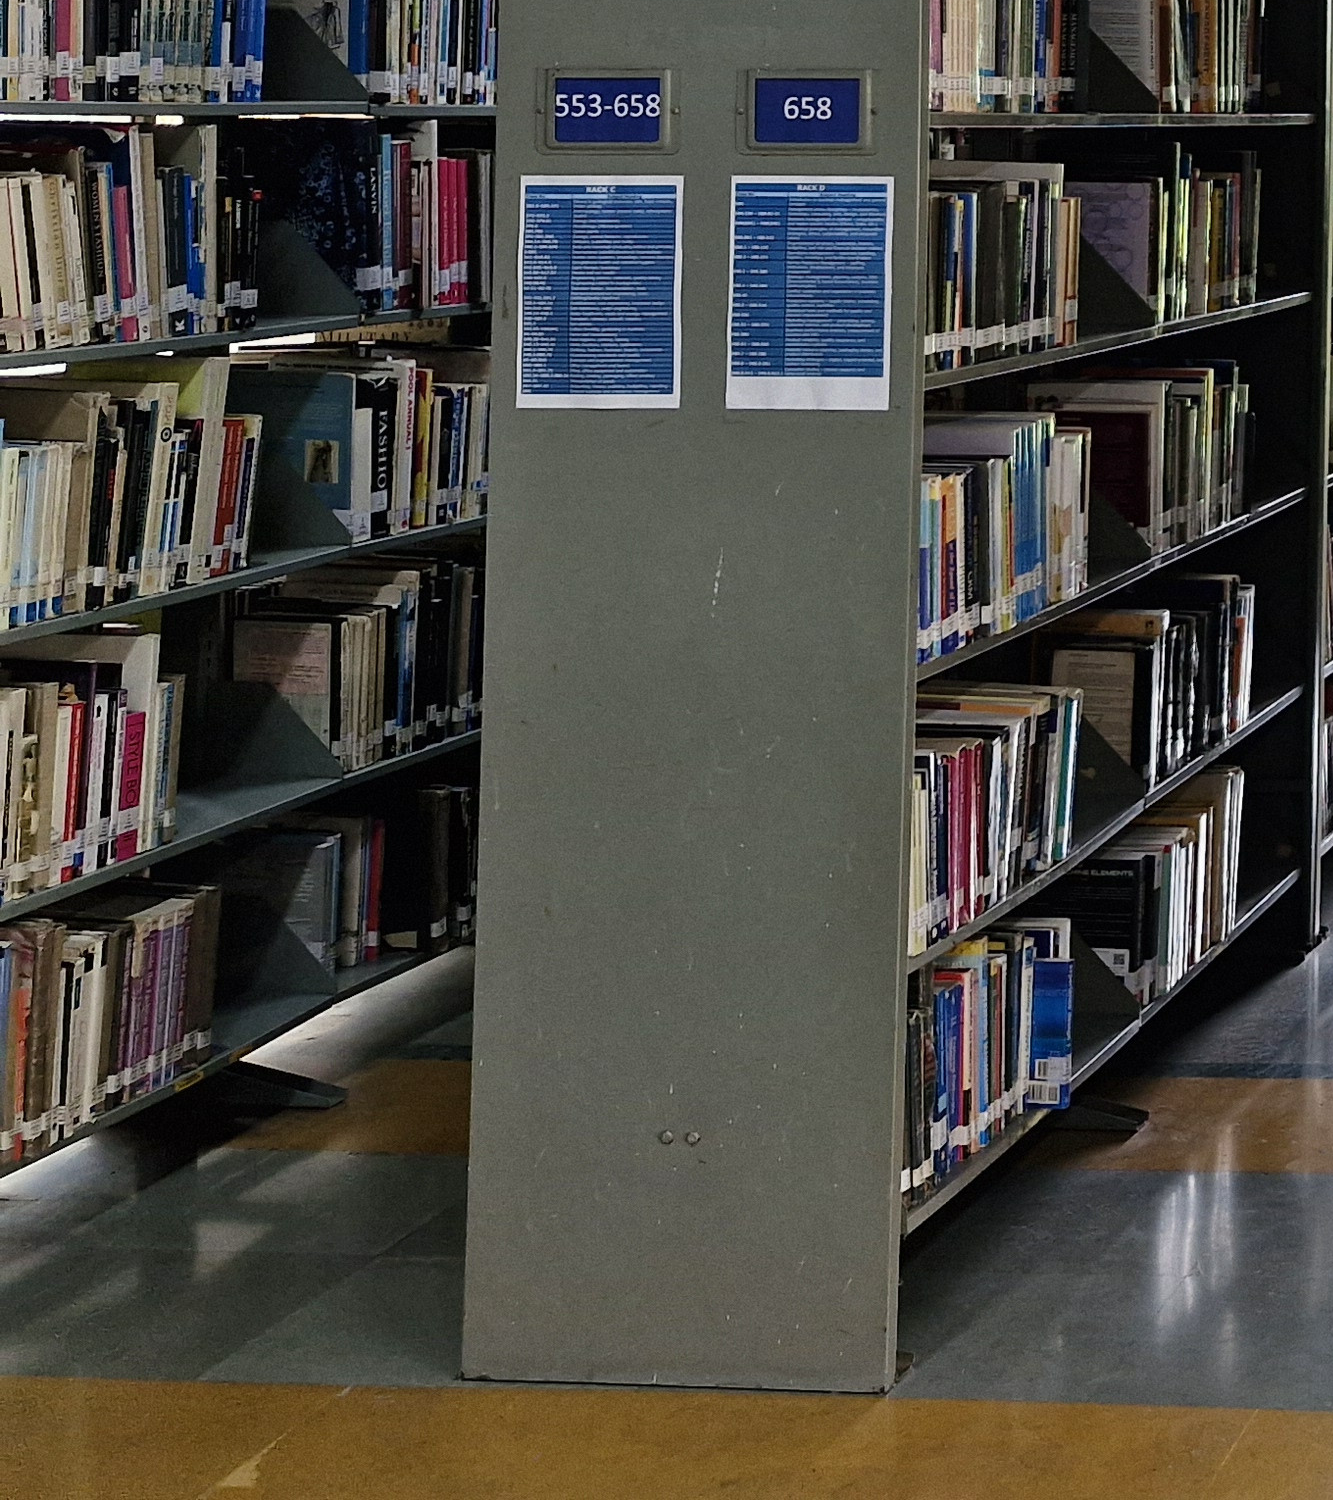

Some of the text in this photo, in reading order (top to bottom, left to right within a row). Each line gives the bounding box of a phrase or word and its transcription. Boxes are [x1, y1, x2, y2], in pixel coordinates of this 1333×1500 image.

[555, 93, 661, 118] 553-658
[783, 96, 832, 120] 658
[369, 166, 378, 215] LANVIN
[93, 231, 105, 278] FASHION
[376, 410, 388, 488] FASHIO
[126, 731, 140, 775] STYLE
